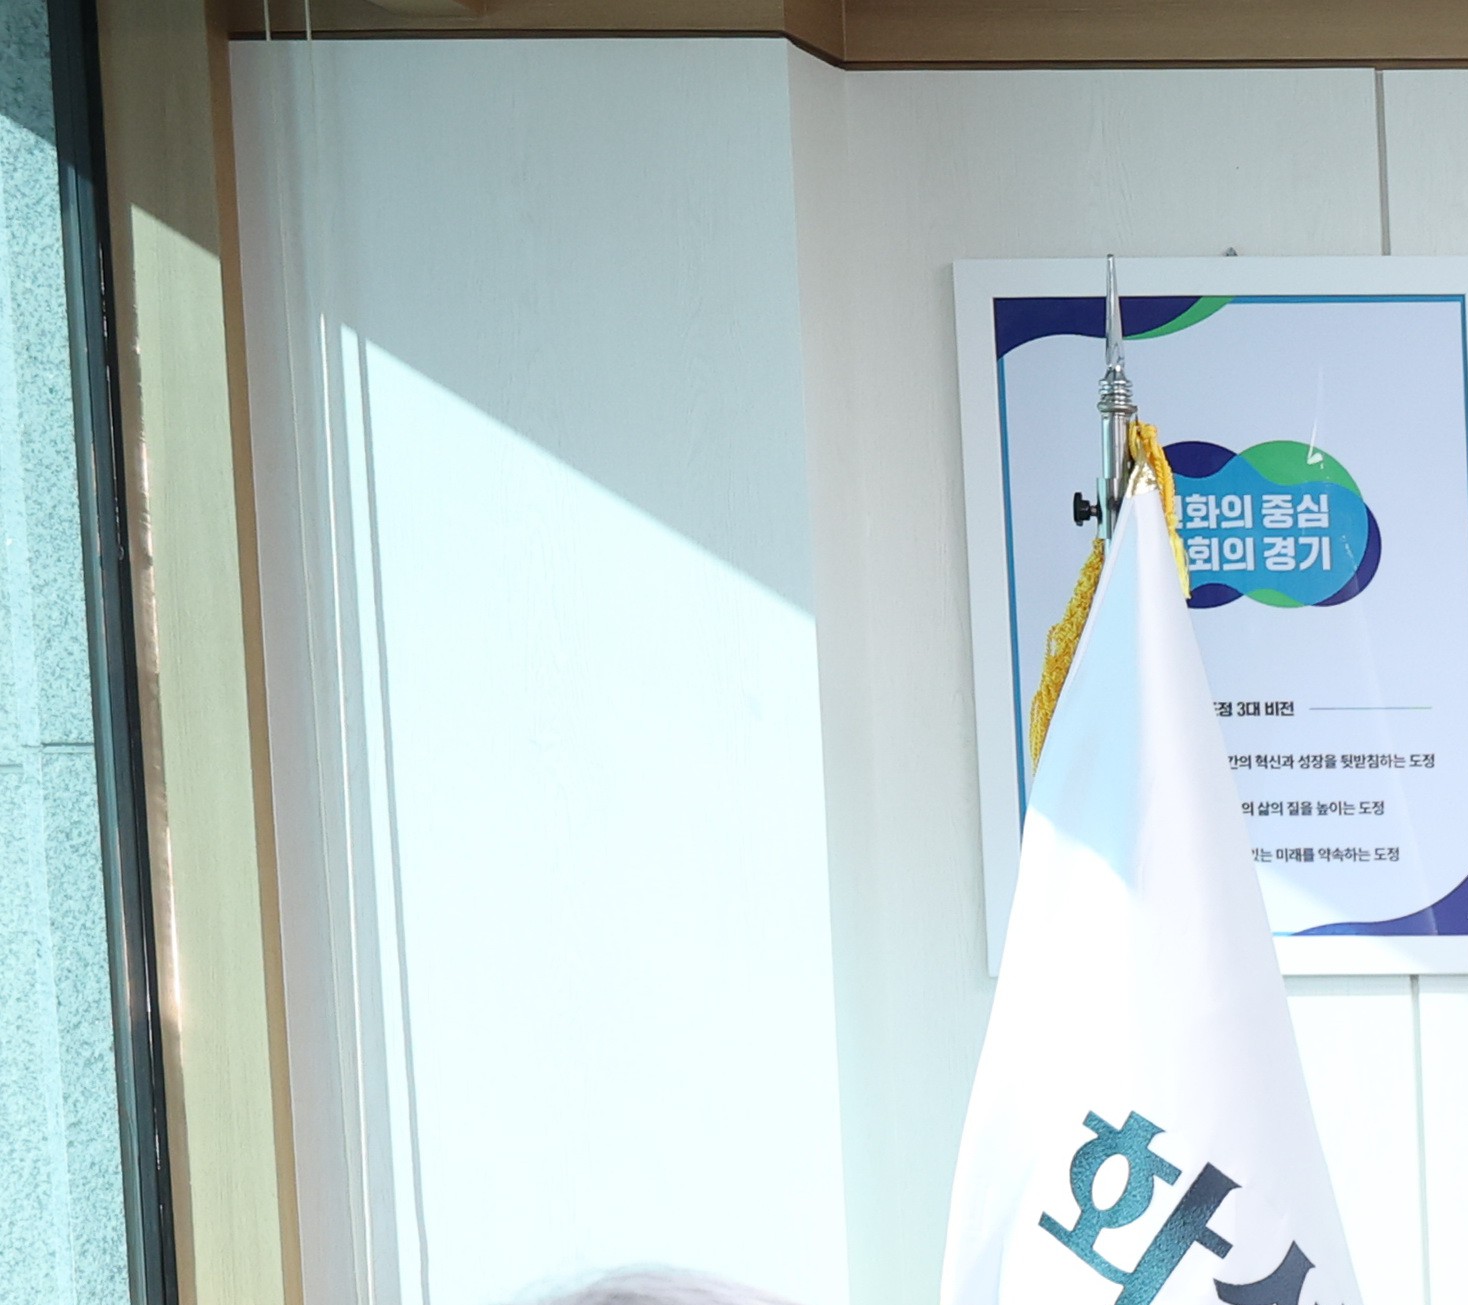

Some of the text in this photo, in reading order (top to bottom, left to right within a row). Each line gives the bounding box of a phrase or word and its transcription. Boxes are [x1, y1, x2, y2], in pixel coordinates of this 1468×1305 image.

[1261, 493, 1329, 530] 중심
[1184, 536, 1331, 571] 회의 경기
[1237, 701, 1261, 717] 3대
[1265, 701, 1295, 717] 비전
[1255, 754, 1294, 770] 혁신과
[1298, 754, 1337, 769] 성장을
[1341, 754, 1406, 769] 뒷받침하는
[1409, 753, 1435, 768] 도정
[1258, 801, 1283, 816] 삶의
[1287, 801, 1313, 816] 질을
[1317, 801, 1355, 816] 높이는
[1359, 801, 1385, 816] 도정
[1252, 847, 1400, 863] 는 미래를 약속하는 도정
